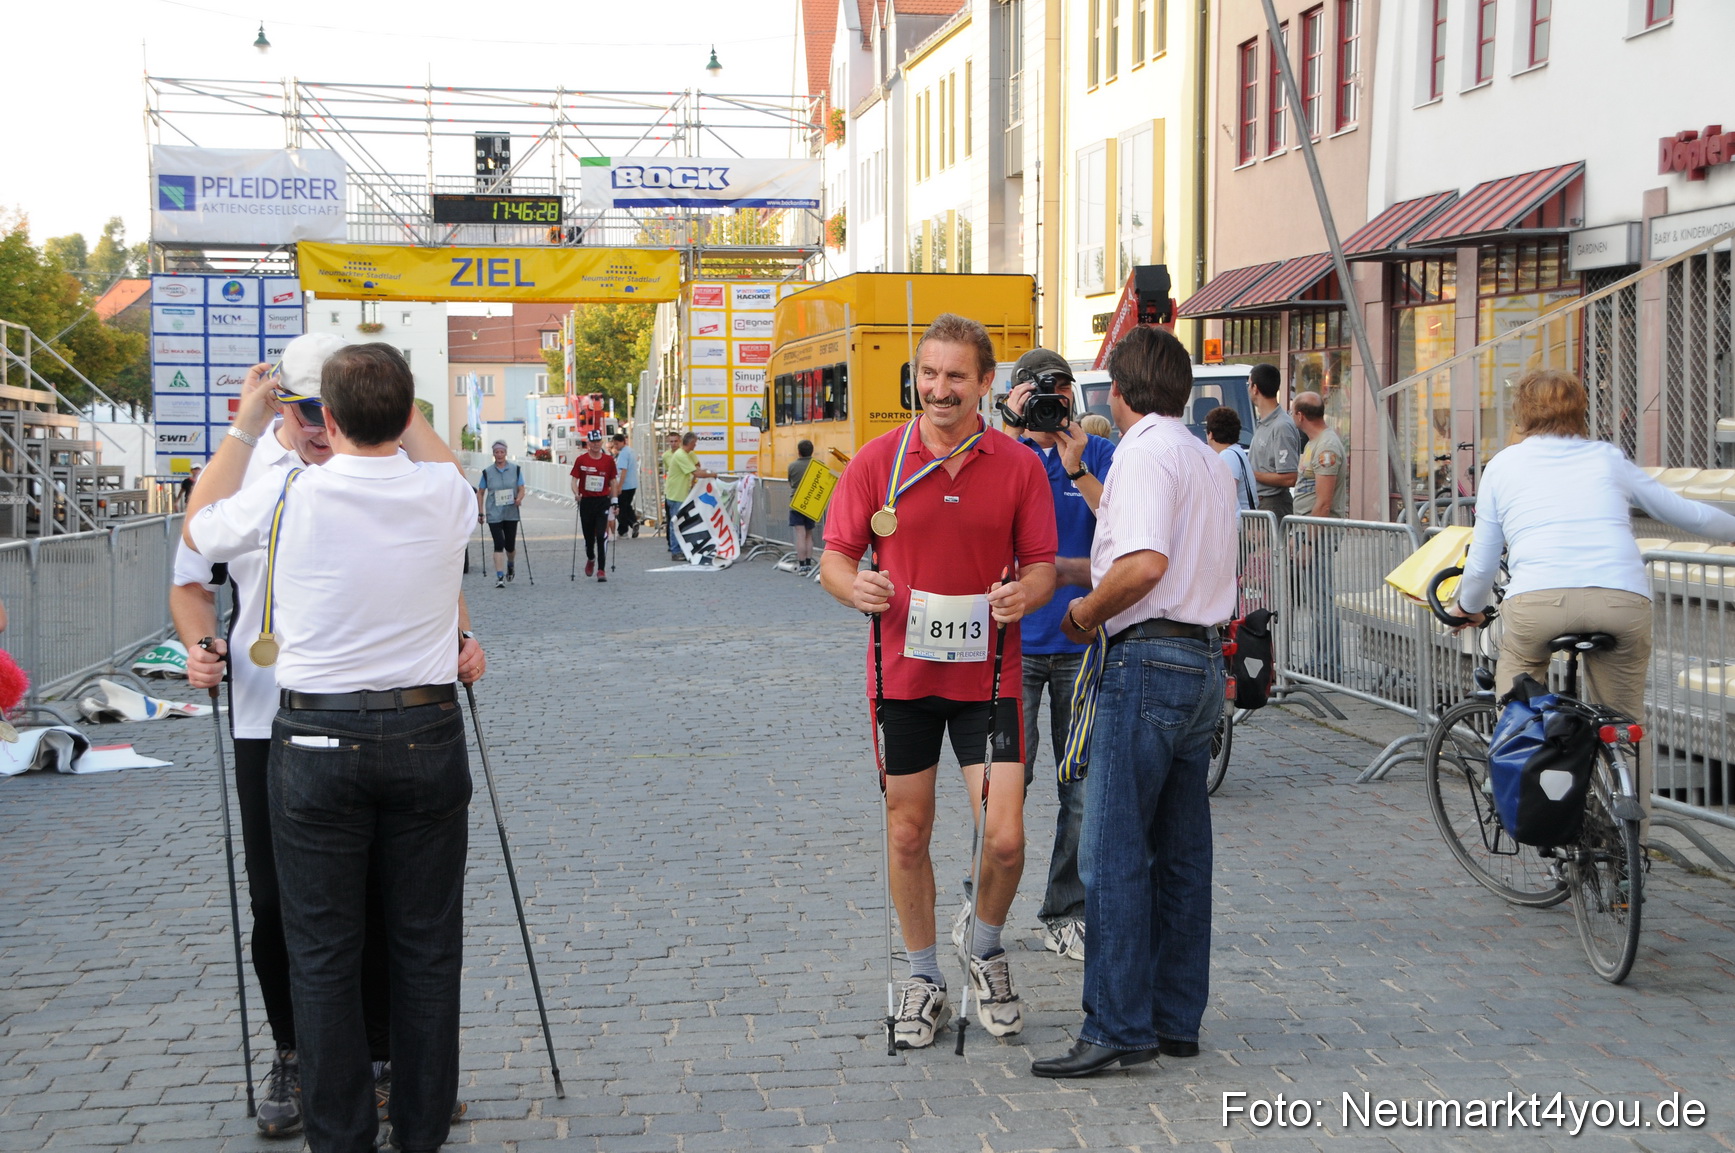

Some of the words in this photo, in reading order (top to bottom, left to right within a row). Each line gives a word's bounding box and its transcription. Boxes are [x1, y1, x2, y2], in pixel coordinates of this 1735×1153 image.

[611, 165, 730, 191] BOCK
[202, 175, 338, 201] PFLEIDERER
[202, 203, 339, 217] AKTIENGESELLSCHAFT
[492, 202, 559, 221] 17:46:28
[1654, 232, 1670, 245] BABY
[1673, 230, 1678, 242] &
[1577, 242, 1608, 256] GARDINEN
[318, 269, 364, 278] Neumarkter
[366, 271, 402, 280] Stadtlauf
[450, 257, 536, 287] ZIEL
[581, 275, 625, 283] Neumarkter
[746, 319, 774, 327] Egner
[735, 371, 765, 382] Sinupr
[735, 383, 759, 392] forte
[160, 434, 187, 442] swn
[800, 468, 823, 511] Schnupper-
[814, 485, 826, 502] lauf
[911, 615, 917, 625] N
[930, 620, 981, 639] 8113
